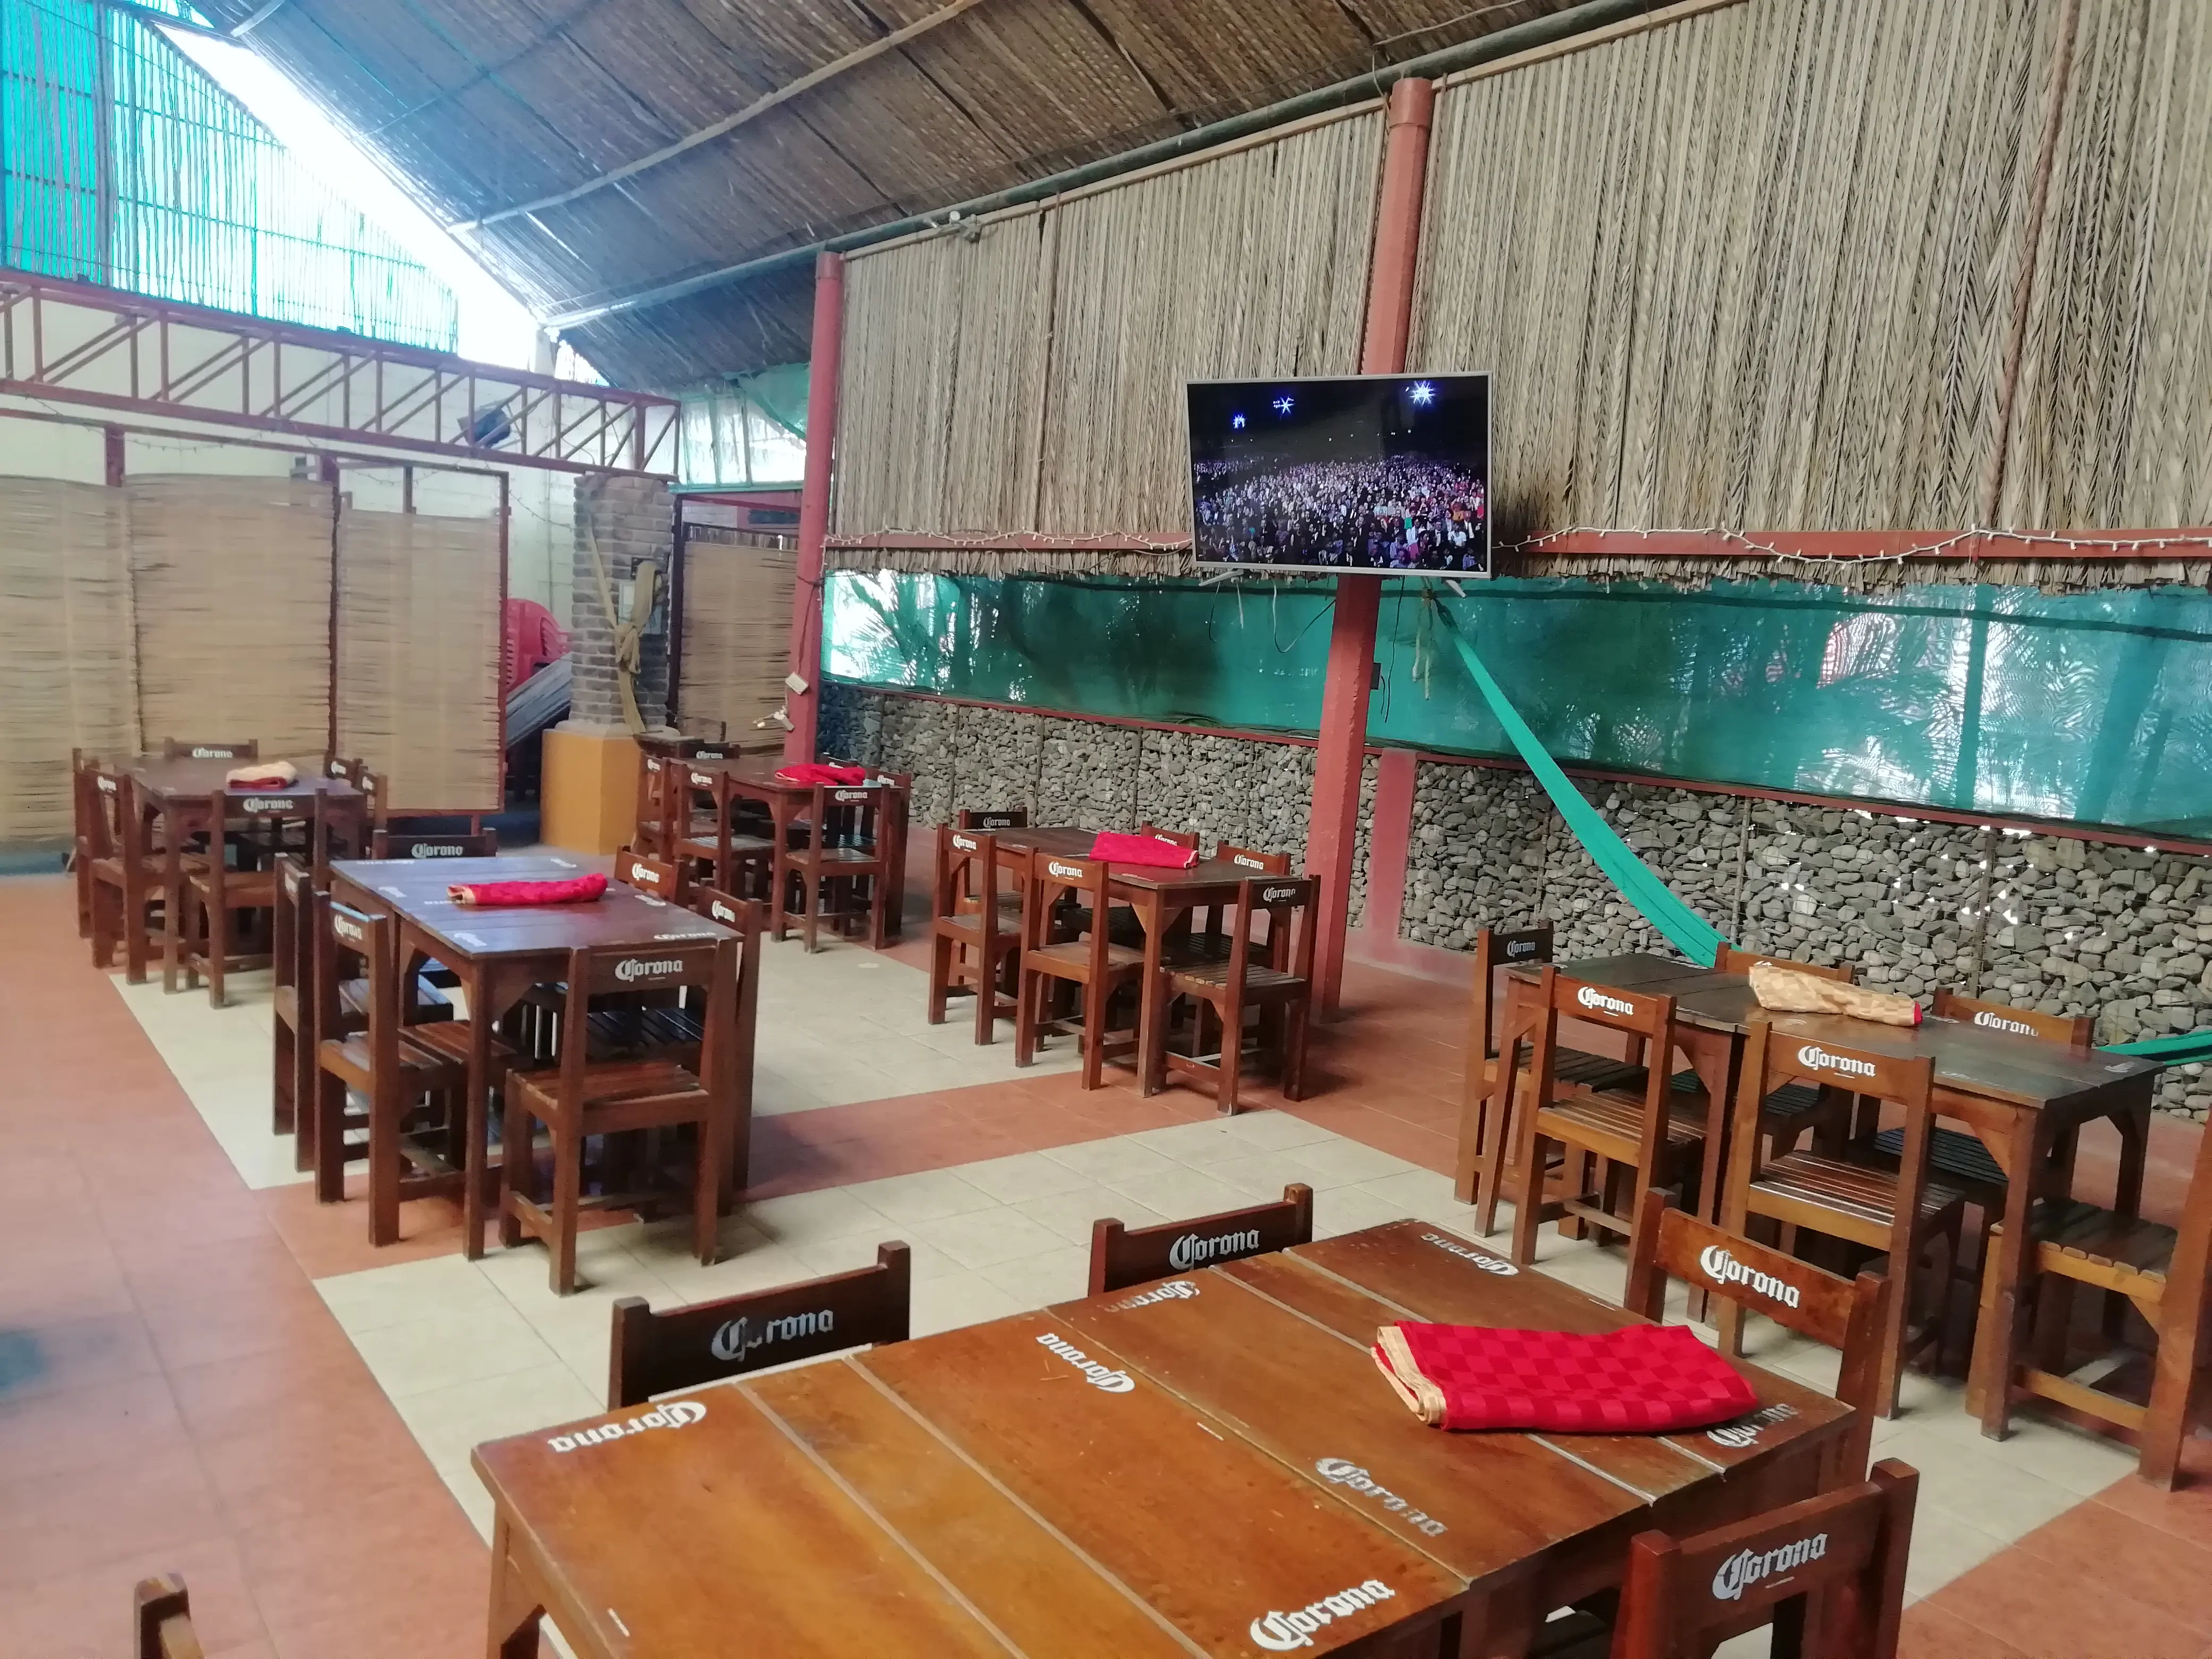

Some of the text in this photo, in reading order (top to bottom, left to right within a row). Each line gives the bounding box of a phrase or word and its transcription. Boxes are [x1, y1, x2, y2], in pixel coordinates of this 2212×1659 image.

[834, 790, 868, 802] Corona
[983, 817, 1010, 828] Corona
[411, 843, 463, 859] Corona
[952, 834, 977, 850] Corona
[1048, 861, 1083, 877] Corona
[1234, 853, 1264, 870] Corona
[1506, 940, 1536, 958] Corona
[615, 958, 684, 982] Corona
[1577, 986, 1633, 1015] Corona
[1798, 1045, 1876, 1077] Corona
[1169, 1229, 1260, 1270] Corona
[1420, 1233, 1520, 1276] Corona
[1700, 1245, 1800, 1310] Corona
[711, 1309, 834, 1362] Crona
[1035, 1333, 1135, 1393] Corona
[547, 1401, 708, 1453] Corona
[1712, 1532, 1828, 1601] Corona
[1250, 1579, 1395, 1652] Corona
